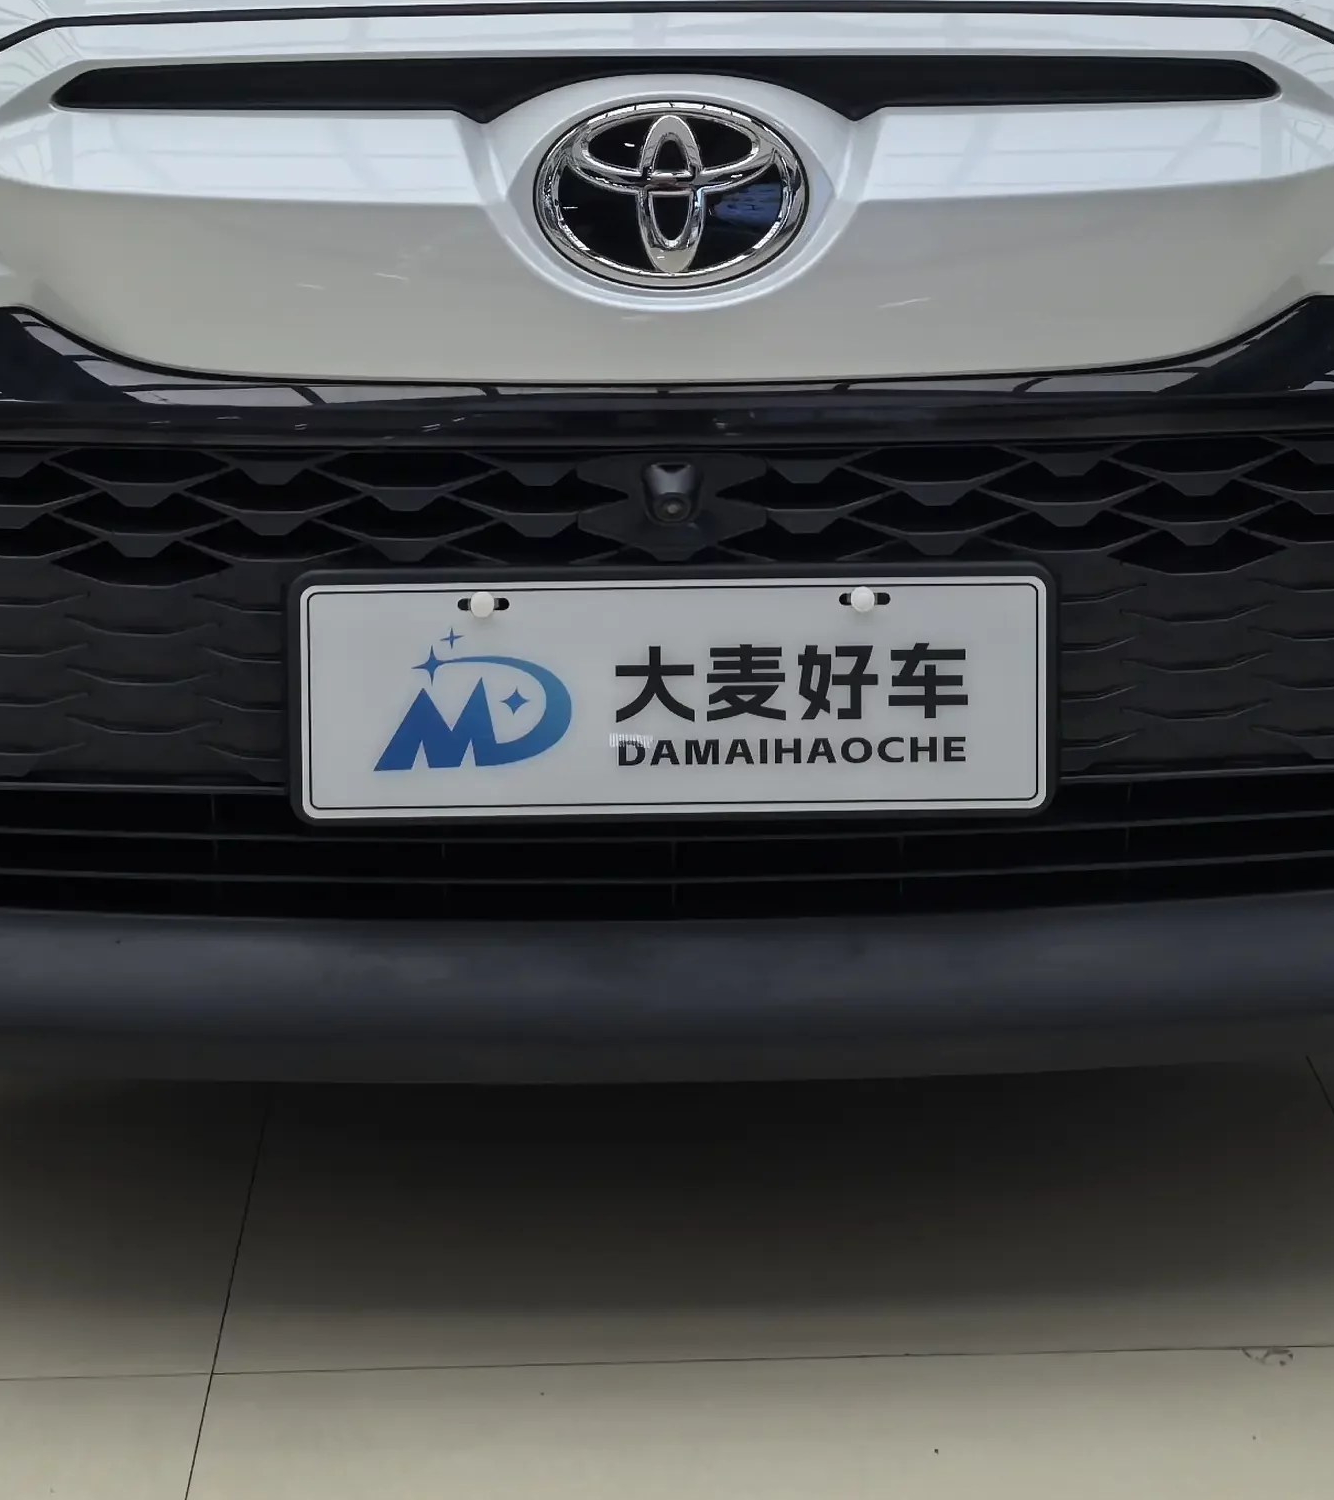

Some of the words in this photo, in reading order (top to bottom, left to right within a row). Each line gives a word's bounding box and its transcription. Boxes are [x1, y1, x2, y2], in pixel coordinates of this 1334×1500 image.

[614, 642, 970, 723] 大麦好车
[617, 736, 967, 767] DAMAIHAOCHE
